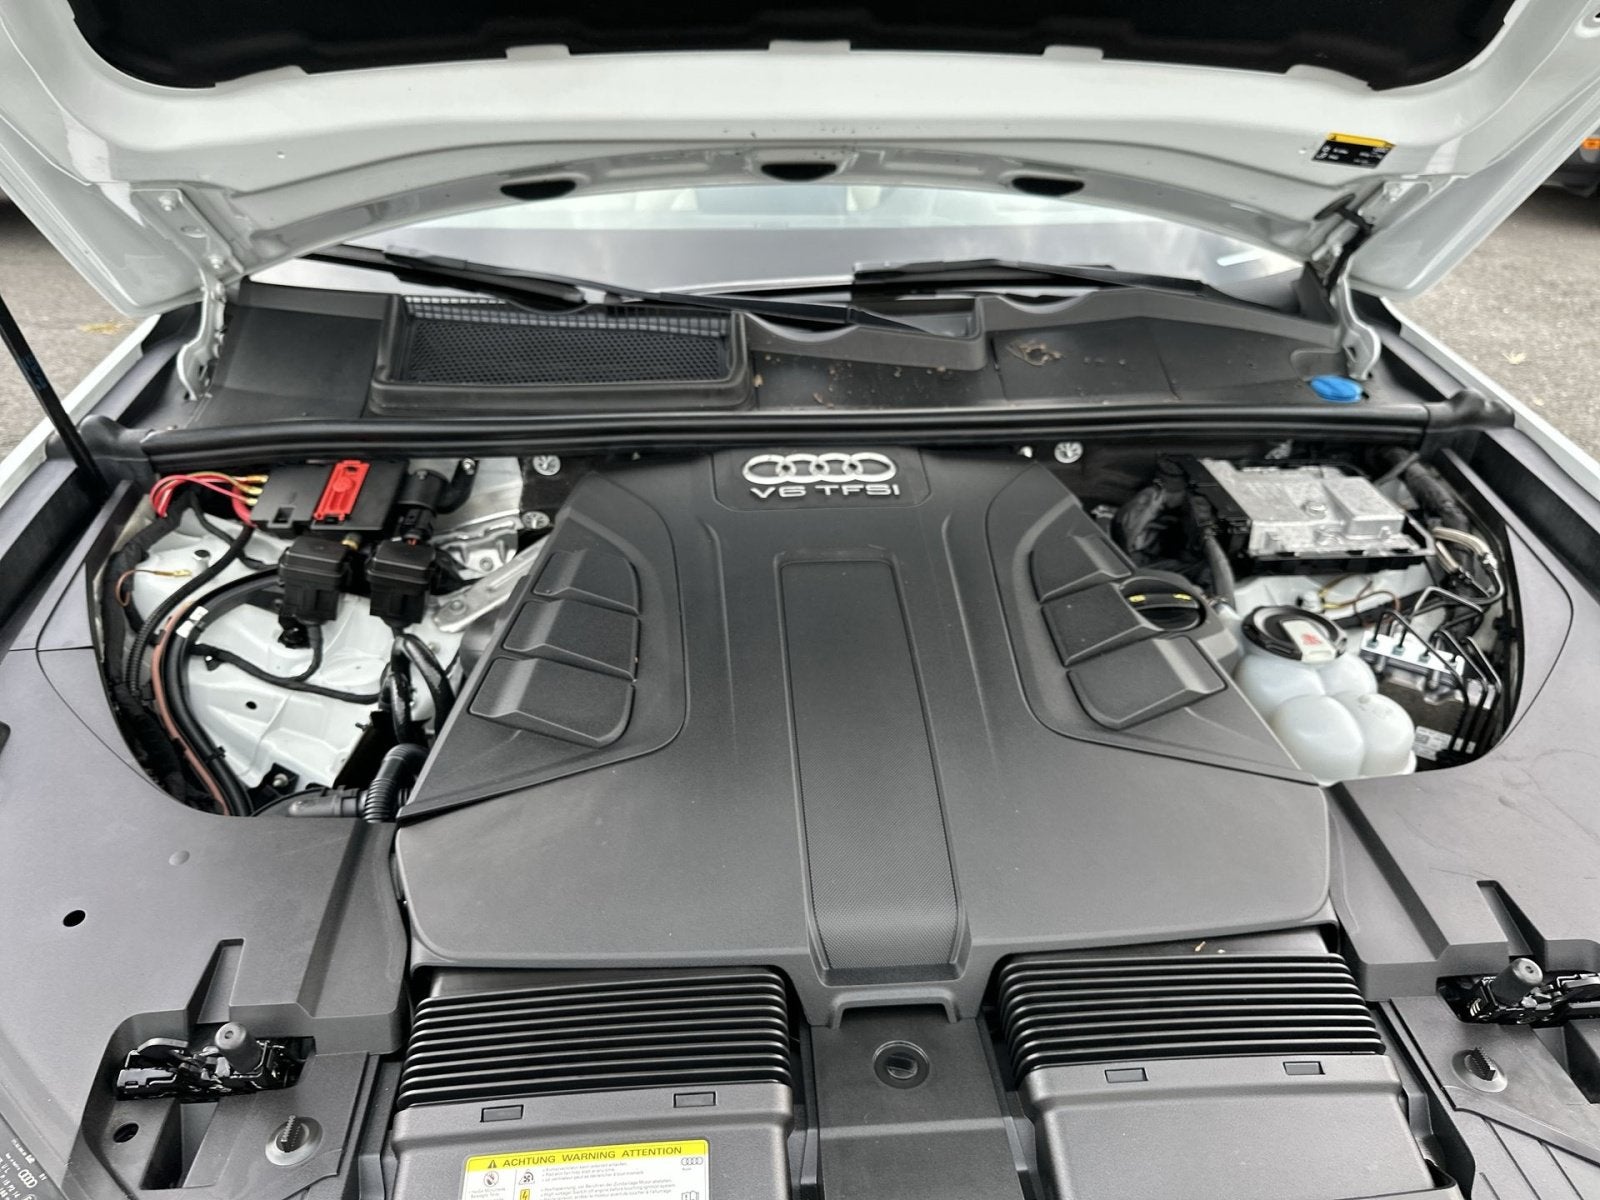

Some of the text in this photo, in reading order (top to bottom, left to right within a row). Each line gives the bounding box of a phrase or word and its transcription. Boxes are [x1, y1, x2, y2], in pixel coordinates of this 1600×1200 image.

[750, 484, 900, 499] V6 TFSI
[502, 1155, 556, 1167] ACHTUNG
[562, 1151, 616, 1162] WARNING
[621, 1147, 682, 1158] ATTENTION
